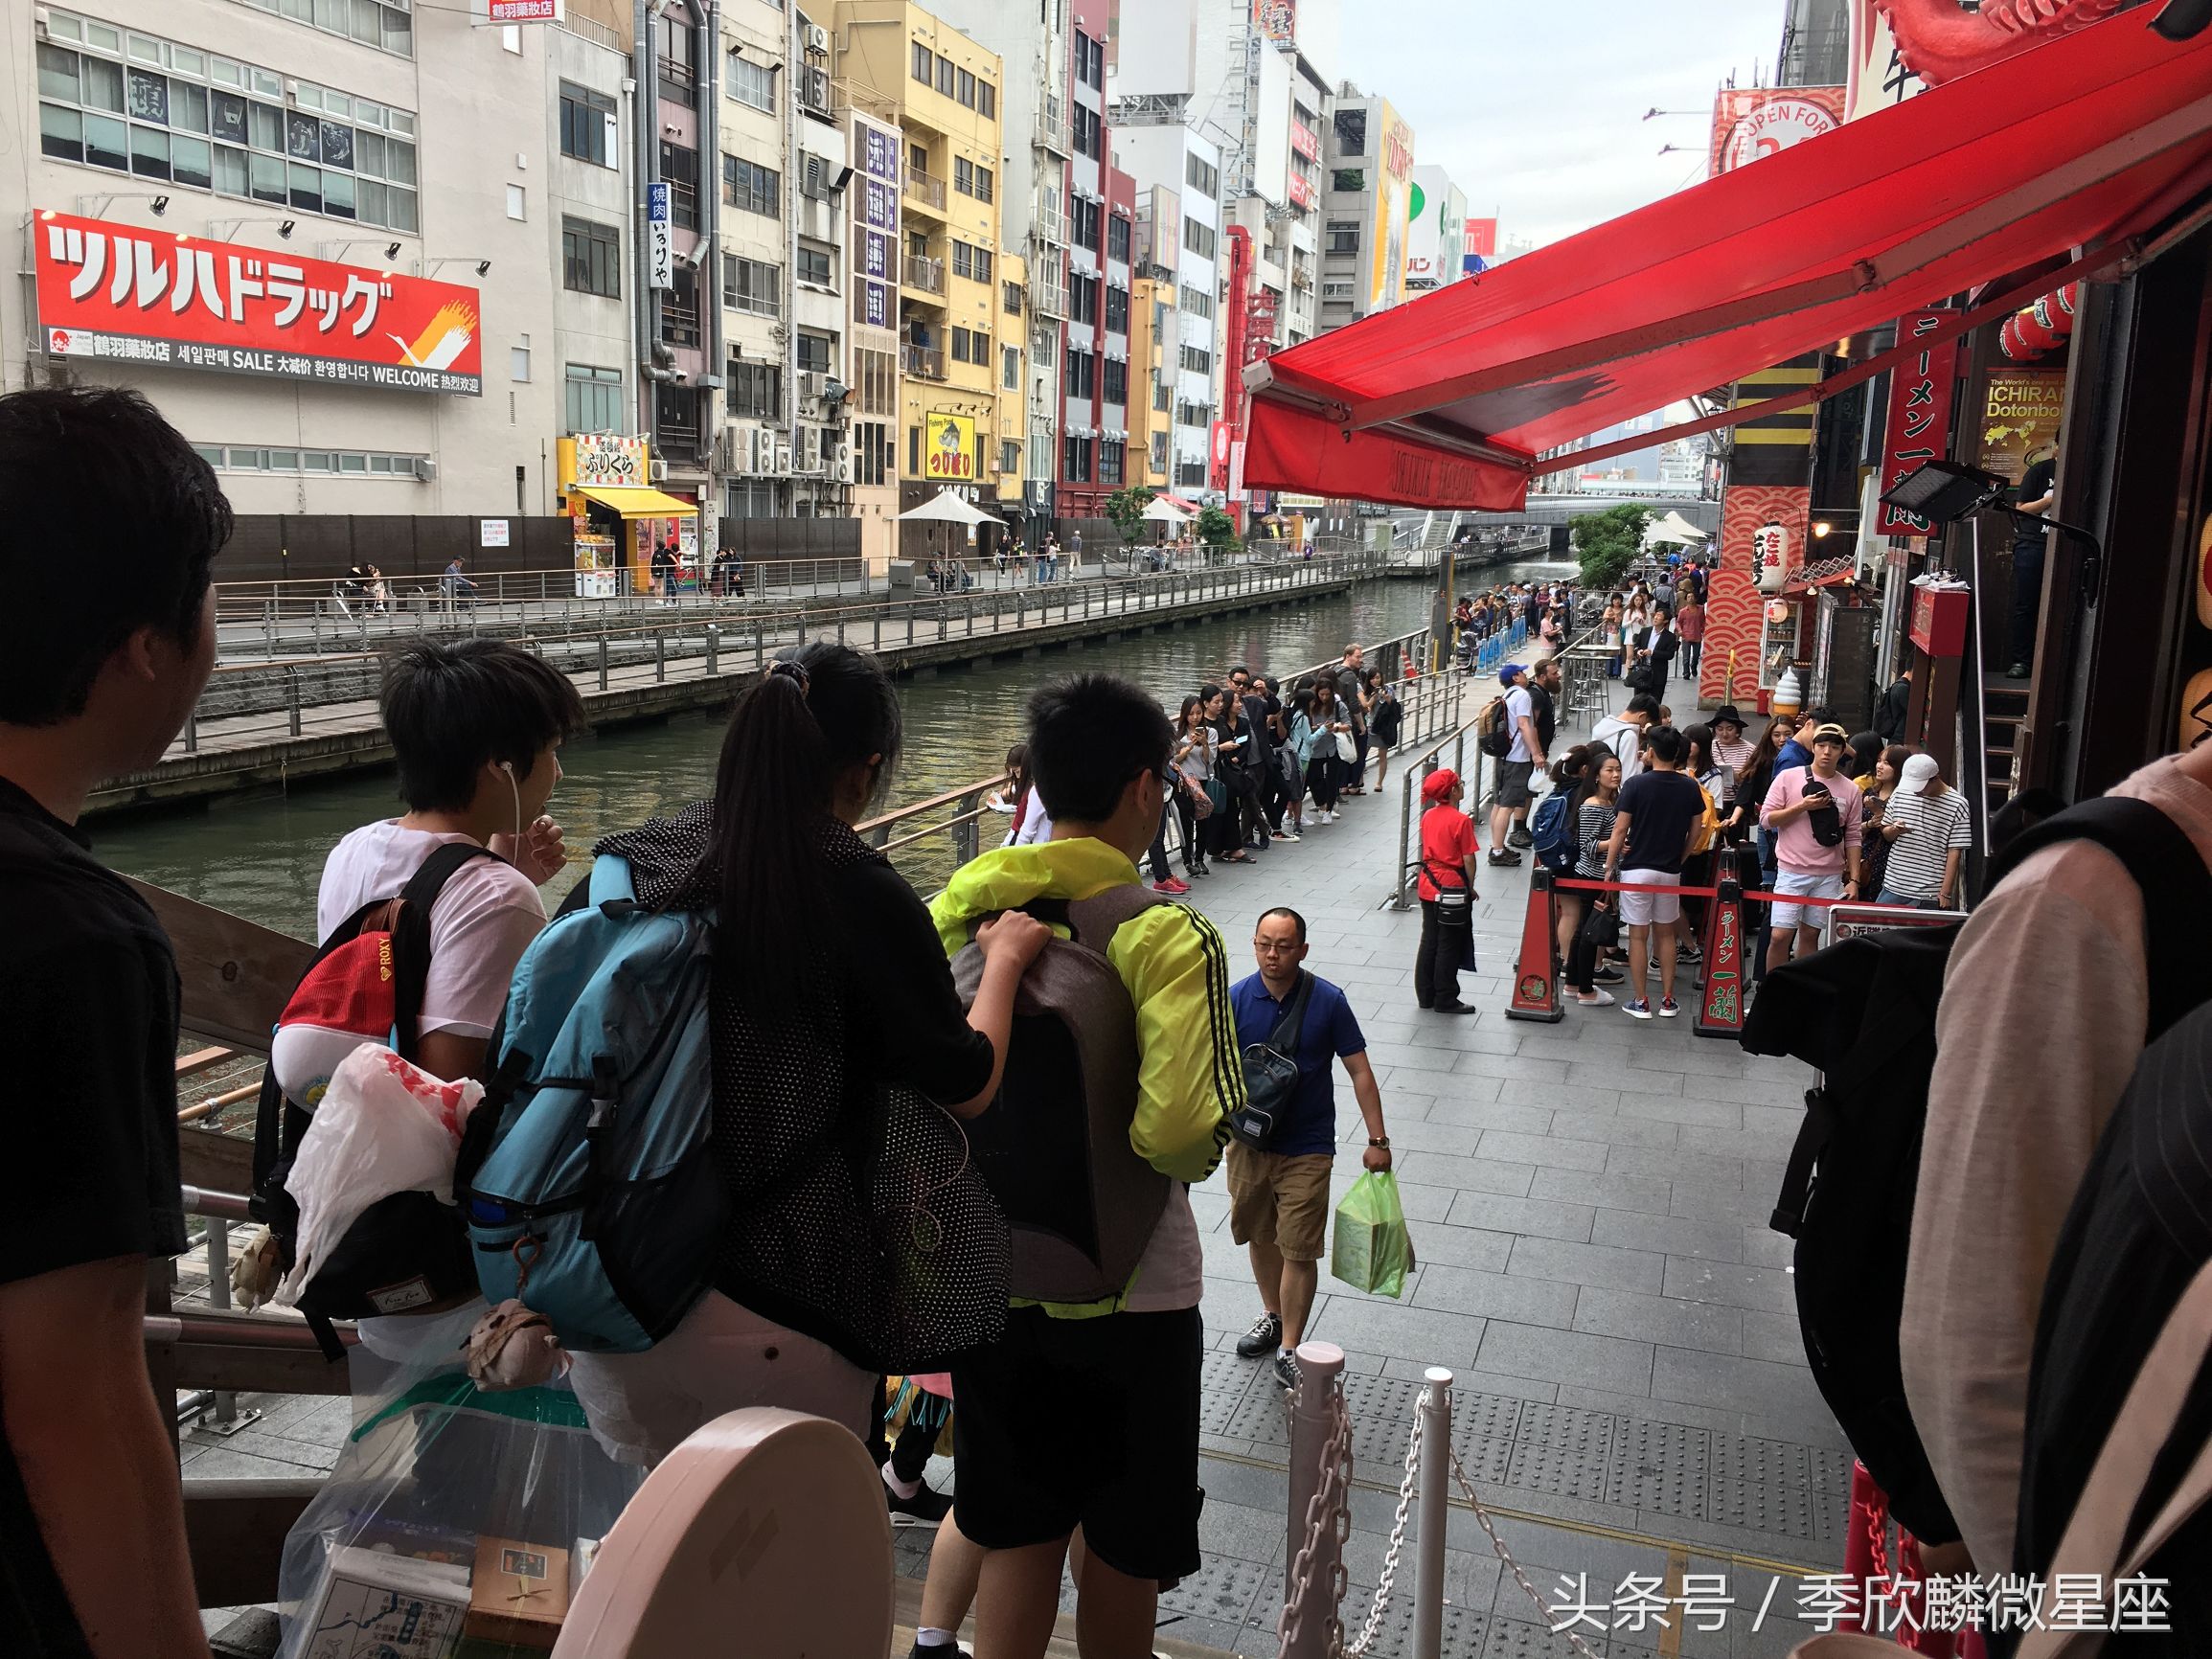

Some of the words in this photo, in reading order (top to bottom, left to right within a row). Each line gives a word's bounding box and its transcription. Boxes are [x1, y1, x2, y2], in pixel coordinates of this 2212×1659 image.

[1746, 105, 1790, 136] OPEN
[1794, 106, 1828, 135] FOR
[652, 187, 666, 218] 焼肉
[654, 223, 668, 284] いろりや
[47, 225, 392, 337] ツルハドラッグ
[94, 335, 170, 362] 鶴羽藥妝店
[177, 345, 229, 367] 세일판매
[233, 351, 273, 372] SALE
[277, 357, 311, 375] 大减价
[314, 360, 369, 381] 환영합니다
[372, 366, 440, 389] WELCOME
[442, 375, 479, 393] 热烈欢迎
[1987, 402, 2063, 418] Dotonbo
[586, 453, 633, 474] ぷりくら
[1764, 532, 1780, 567] たこ焼
[378, 938, 392, 966] ROXY
